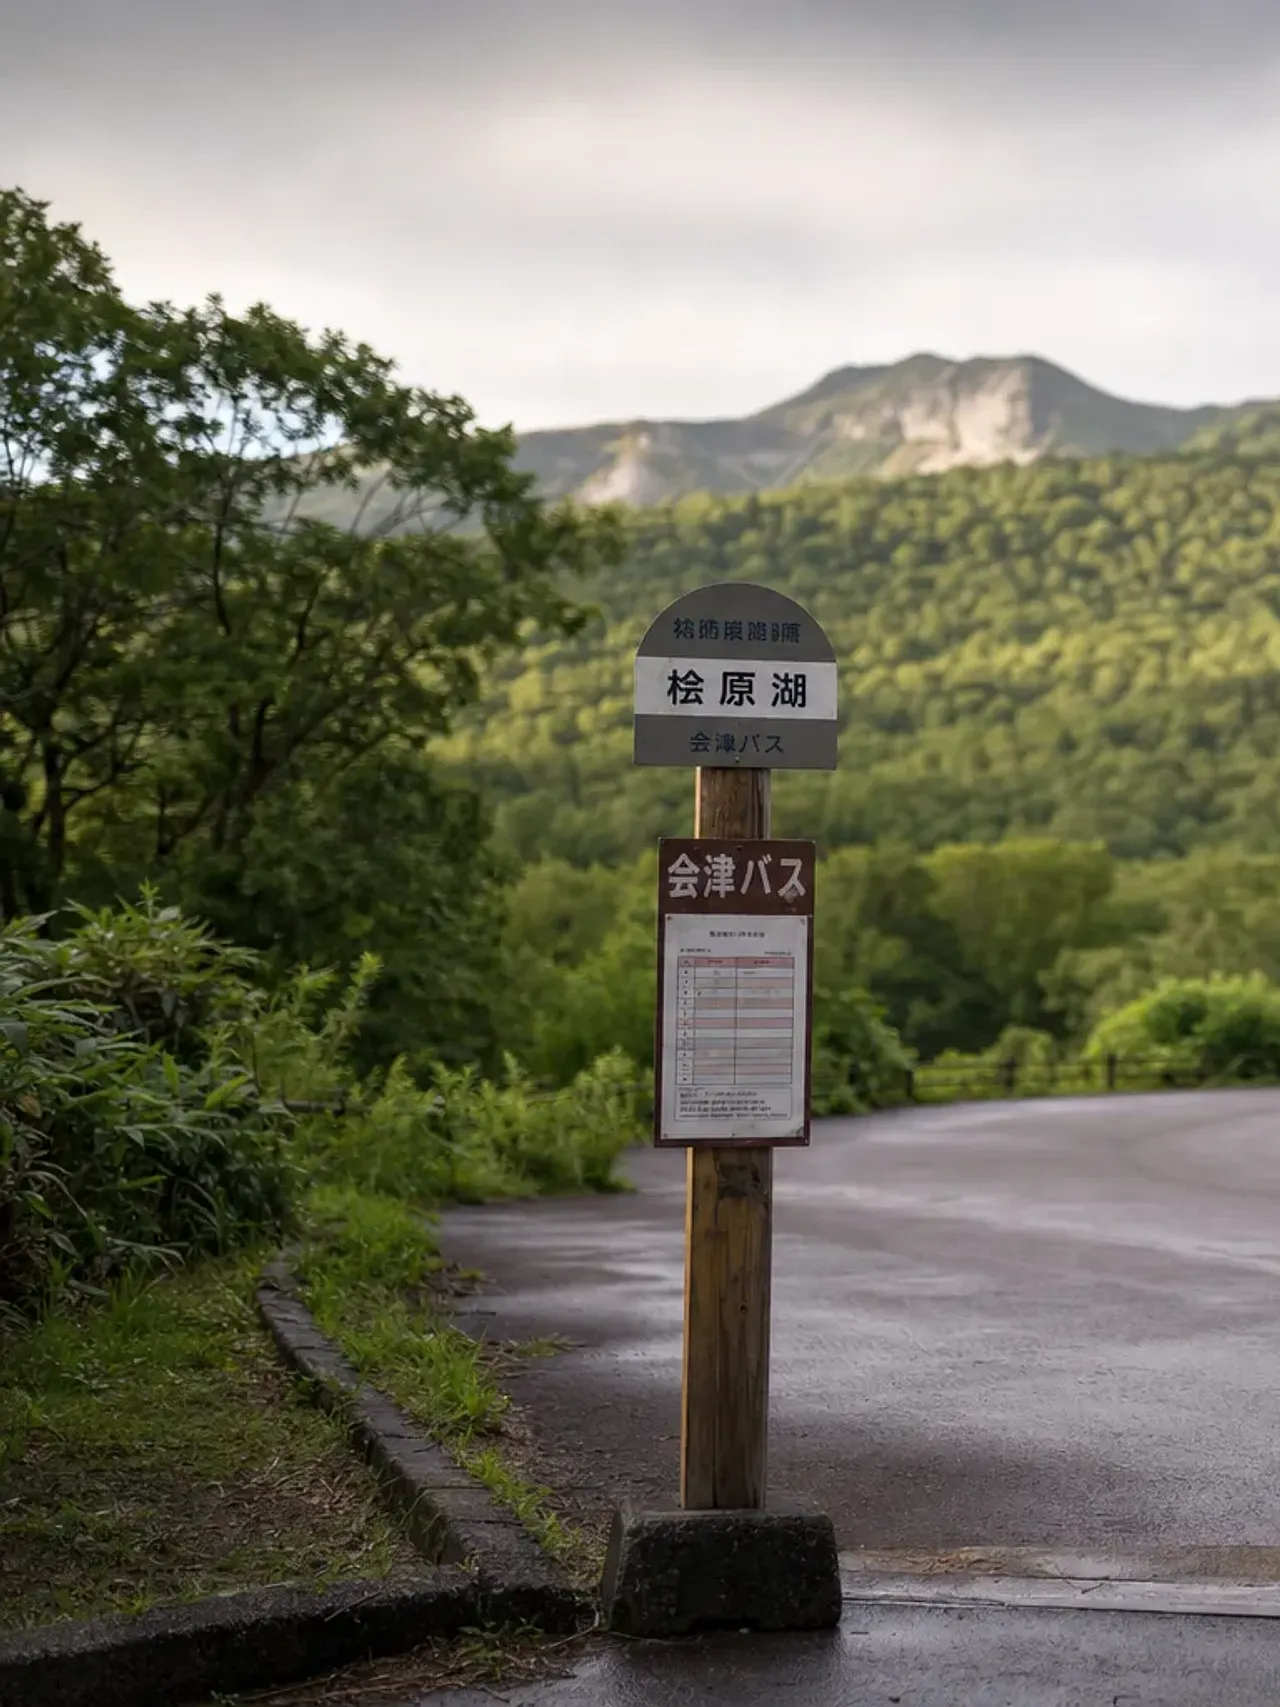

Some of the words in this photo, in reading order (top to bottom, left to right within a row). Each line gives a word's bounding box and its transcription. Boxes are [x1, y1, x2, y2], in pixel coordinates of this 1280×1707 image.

[667, 669, 807, 708] 桧原湖
[667, 852, 807, 899] 会津バス
